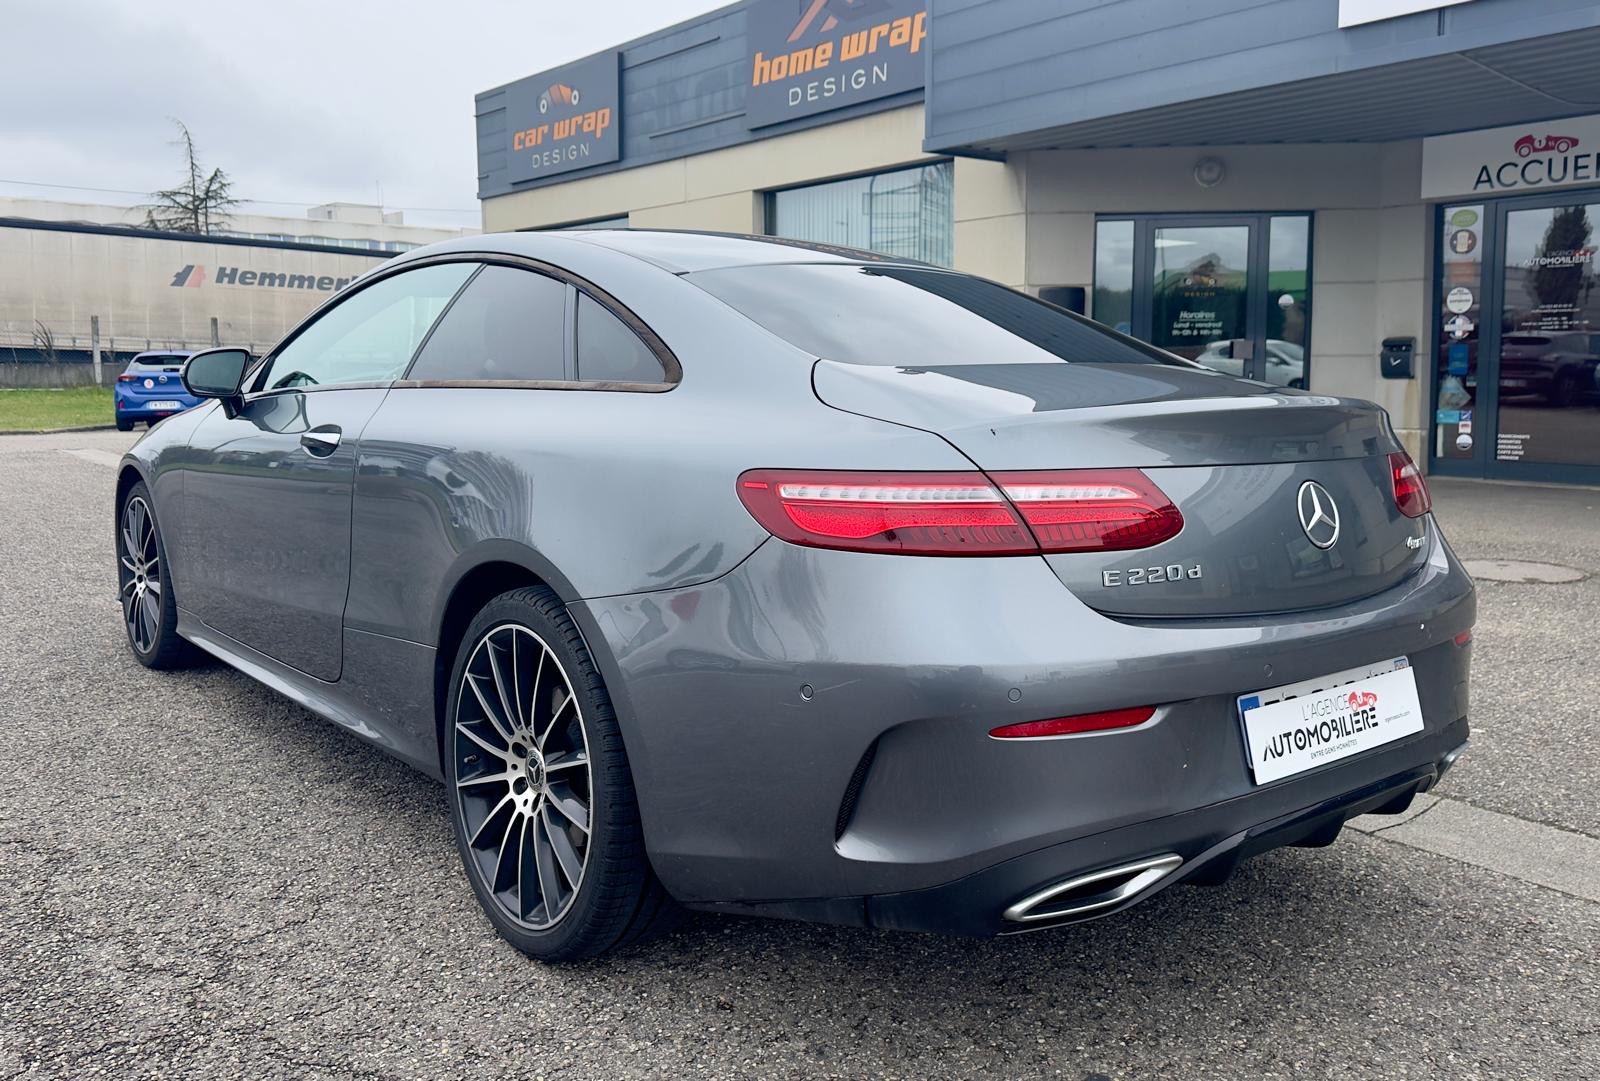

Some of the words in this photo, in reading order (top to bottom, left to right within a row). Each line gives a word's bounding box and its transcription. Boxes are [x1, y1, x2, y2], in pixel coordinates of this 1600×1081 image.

[752, 41, 834, 87] home
[840, 11, 928, 62] wrap
[788, 62, 888, 107] DESIGN
[513, 124, 549, 151] car
[552, 107, 610, 139] wrap
[532, 143, 589, 168] DESIGN
[215, 266, 359, 292] Hemmer
[1180, 310, 1216, 319] Horaires
[1102, 570, 1122, 587] E
[1127, 564, 1184, 586] 220
[1186, 564, 1202, 579] d
[1301, 693, 1350, 721] L'AGENCE
[1264, 707, 1379, 762] AUTOMOBILIERE
